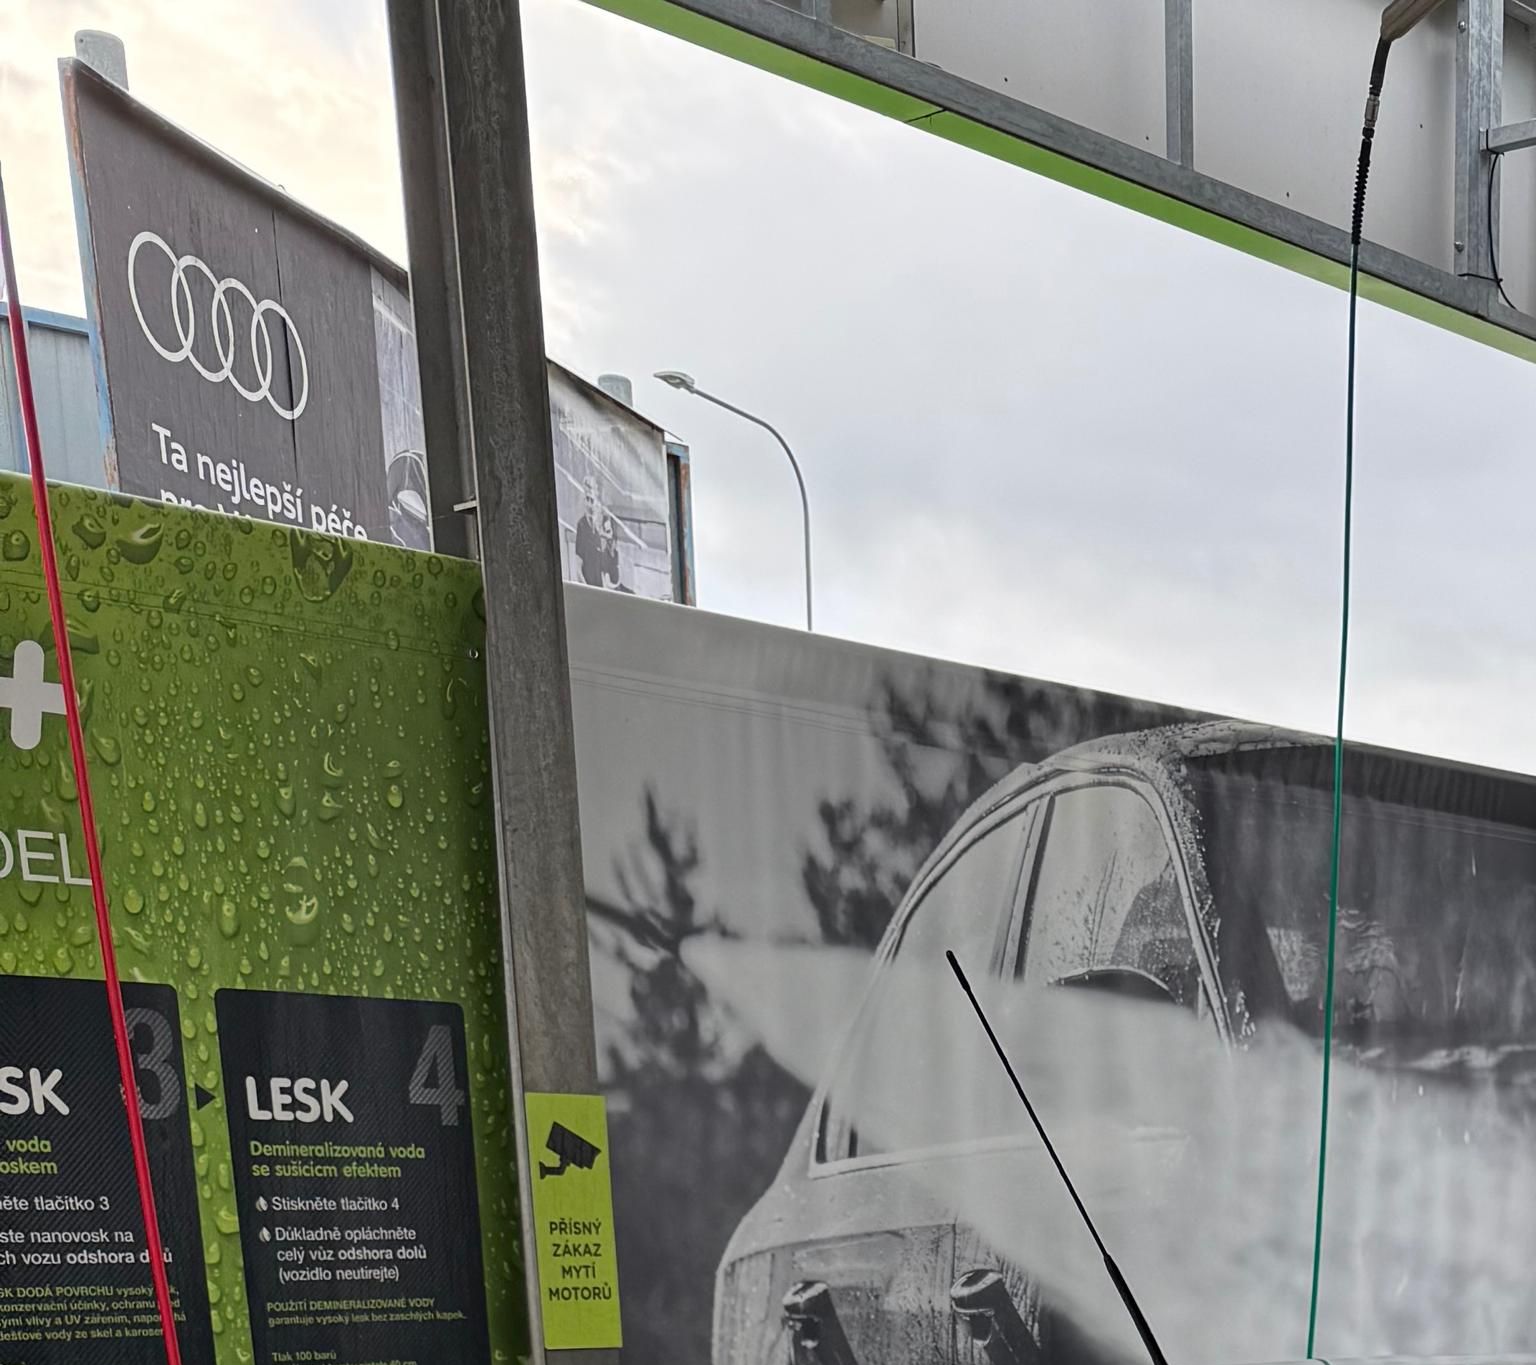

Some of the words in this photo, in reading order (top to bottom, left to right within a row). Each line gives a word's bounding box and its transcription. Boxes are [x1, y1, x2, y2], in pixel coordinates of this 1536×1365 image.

[152, 423, 188, 473] Ta
[197, 453, 303, 523] nejlepší
[311, 502, 367, 540] péče
[408, 1024, 464, 1126] 4
[245, 1075, 354, 1123] LESK
[6, 1136, 52, 1152] voda
[250, 1140, 385, 1158] Demineralizovaná
[389, 1143, 426, 1159] voda
[252, 1163, 270, 1176] se
[342, 1161, 402, 1178] efektem
[34, 1195, 95, 1211] tlačítko
[100, 1196, 110, 1210] 3
[272, 1195, 337, 1211] Stiskněte
[341, 1195, 388, 1211] tlačítko
[391, 1197, 400, 1210] 4
[275, 1226, 341, 1241] Důkladně
[344, 1226, 416, 1243] opláchněte
[549, 1217, 602, 1236] PŘÍSNÝ
[30, 1228, 109, 1243] nanovosk
[114, 1230, 134, 1243] na
[21, 1253, 61, 1265] vozu
[66, 1250, 135, 1265] odshora
[139, 1248, 173, 1264] dů
[276, 1246, 306, 1264] celý
[309, 1245, 335, 1261] vůz
[338, 1246, 393, 1260] odshora
[396, 1243, 427, 1260] dolů
[552, 1239, 602, 1257] ZÁKAZ
[279, 1267, 332, 1284] (vozidlo
[561, 1261, 596, 1279] MYTÍ
[16, 1284, 53, 1297] DODÁ
[56, 1286, 114, 1297] POVRCHU
[548, 1281, 612, 1301] MOTORŮ
[65, 1314, 81, 1325] UV
[45, 1329, 72, 1341] vody
